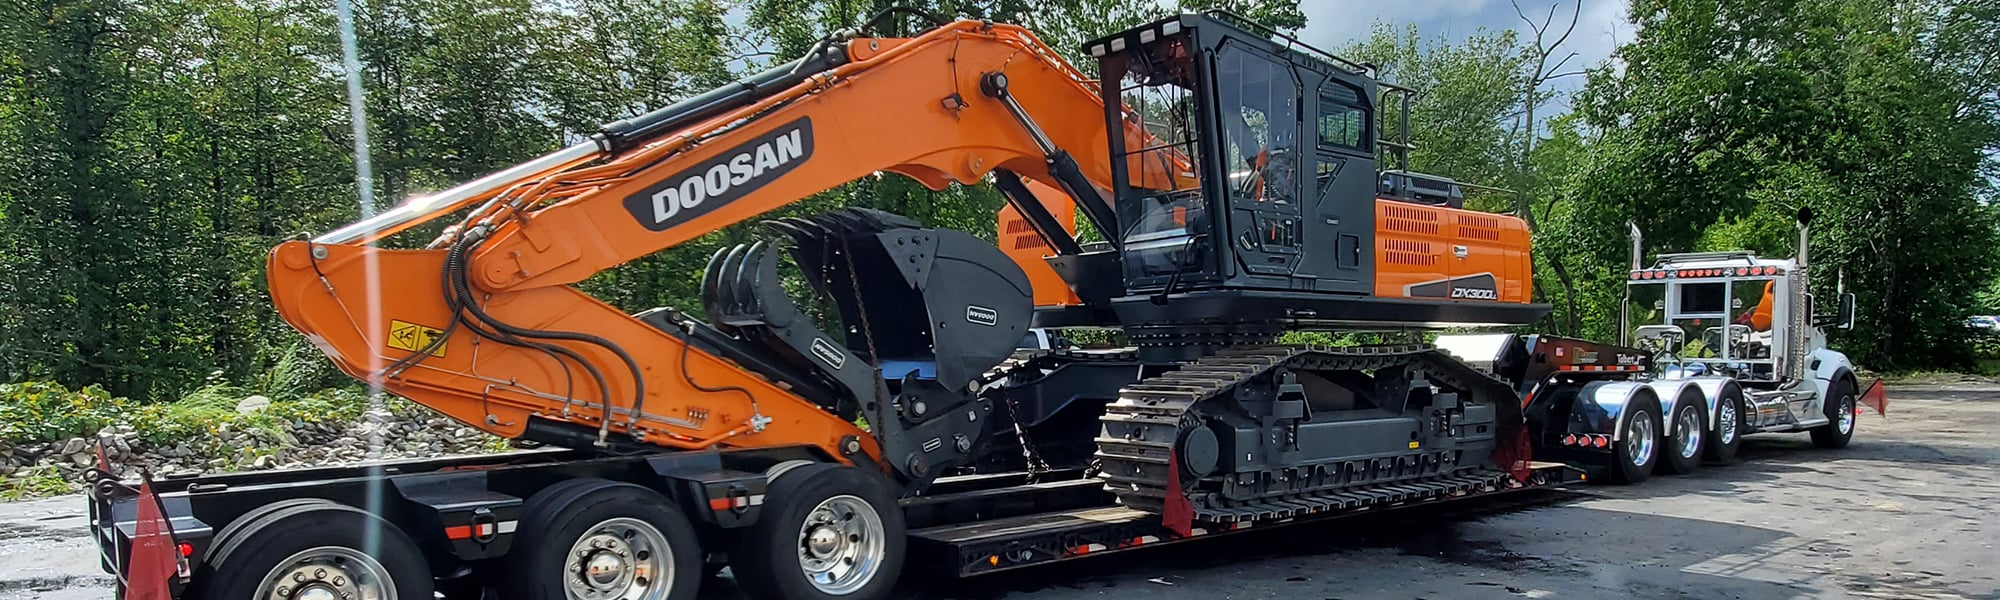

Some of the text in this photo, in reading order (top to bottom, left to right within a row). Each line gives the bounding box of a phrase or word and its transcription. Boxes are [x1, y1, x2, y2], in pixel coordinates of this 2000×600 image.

[652, 128, 803, 224] DOOSAN
[969, 310, 995, 320] DOOSAN
[815, 343, 842, 363] DOOSAN
